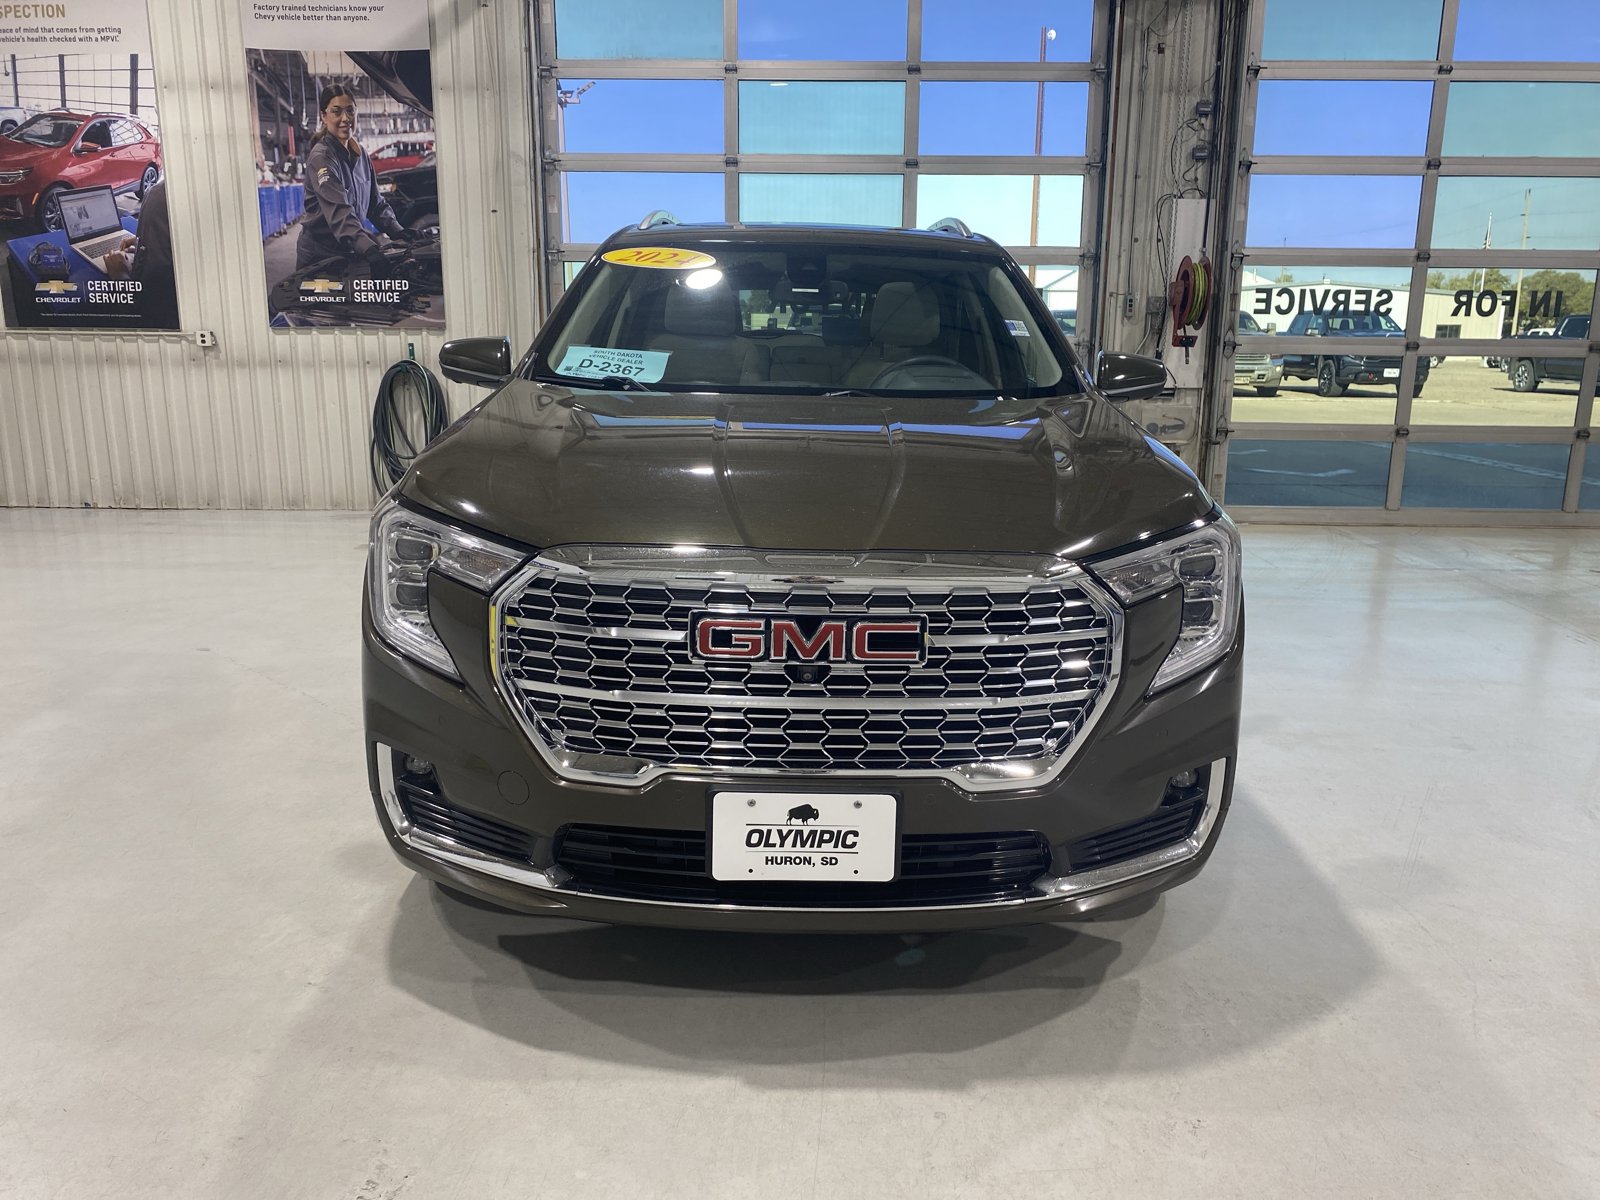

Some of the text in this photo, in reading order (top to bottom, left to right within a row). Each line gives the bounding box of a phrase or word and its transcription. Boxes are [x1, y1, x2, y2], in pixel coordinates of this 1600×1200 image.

[253, 4, 384, 13] Factory trained technicians know your
[254, 13, 275, 21] Chevy
[276, 13, 301, 21] vehicle
[97, 27, 122, 35] getting
[26, 35, 48, 43] health
[49, 35, 77, 43] checked
[78, 35, 93, 43] with
[614, 250, 701, 265] 2024
[87, 280, 143, 293] CERTIFIED
[353, 279, 409, 291] CERTIFIED
[88, 292, 134, 305] SERVICE
[299, 295, 346, 304] CHEVROLET
[353, 291, 400, 304] SERVICE
[588, 354, 644, 366] VEHICLE DEALER
[593, 349, 643, 360] SOUTH DAKOTA
[578, 358, 645, 377] D-2367
[695, 617, 923, 662] GMC
[745, 828, 859, 850] OLYMPIC
[764, 855, 839, 868] HURON, SD
